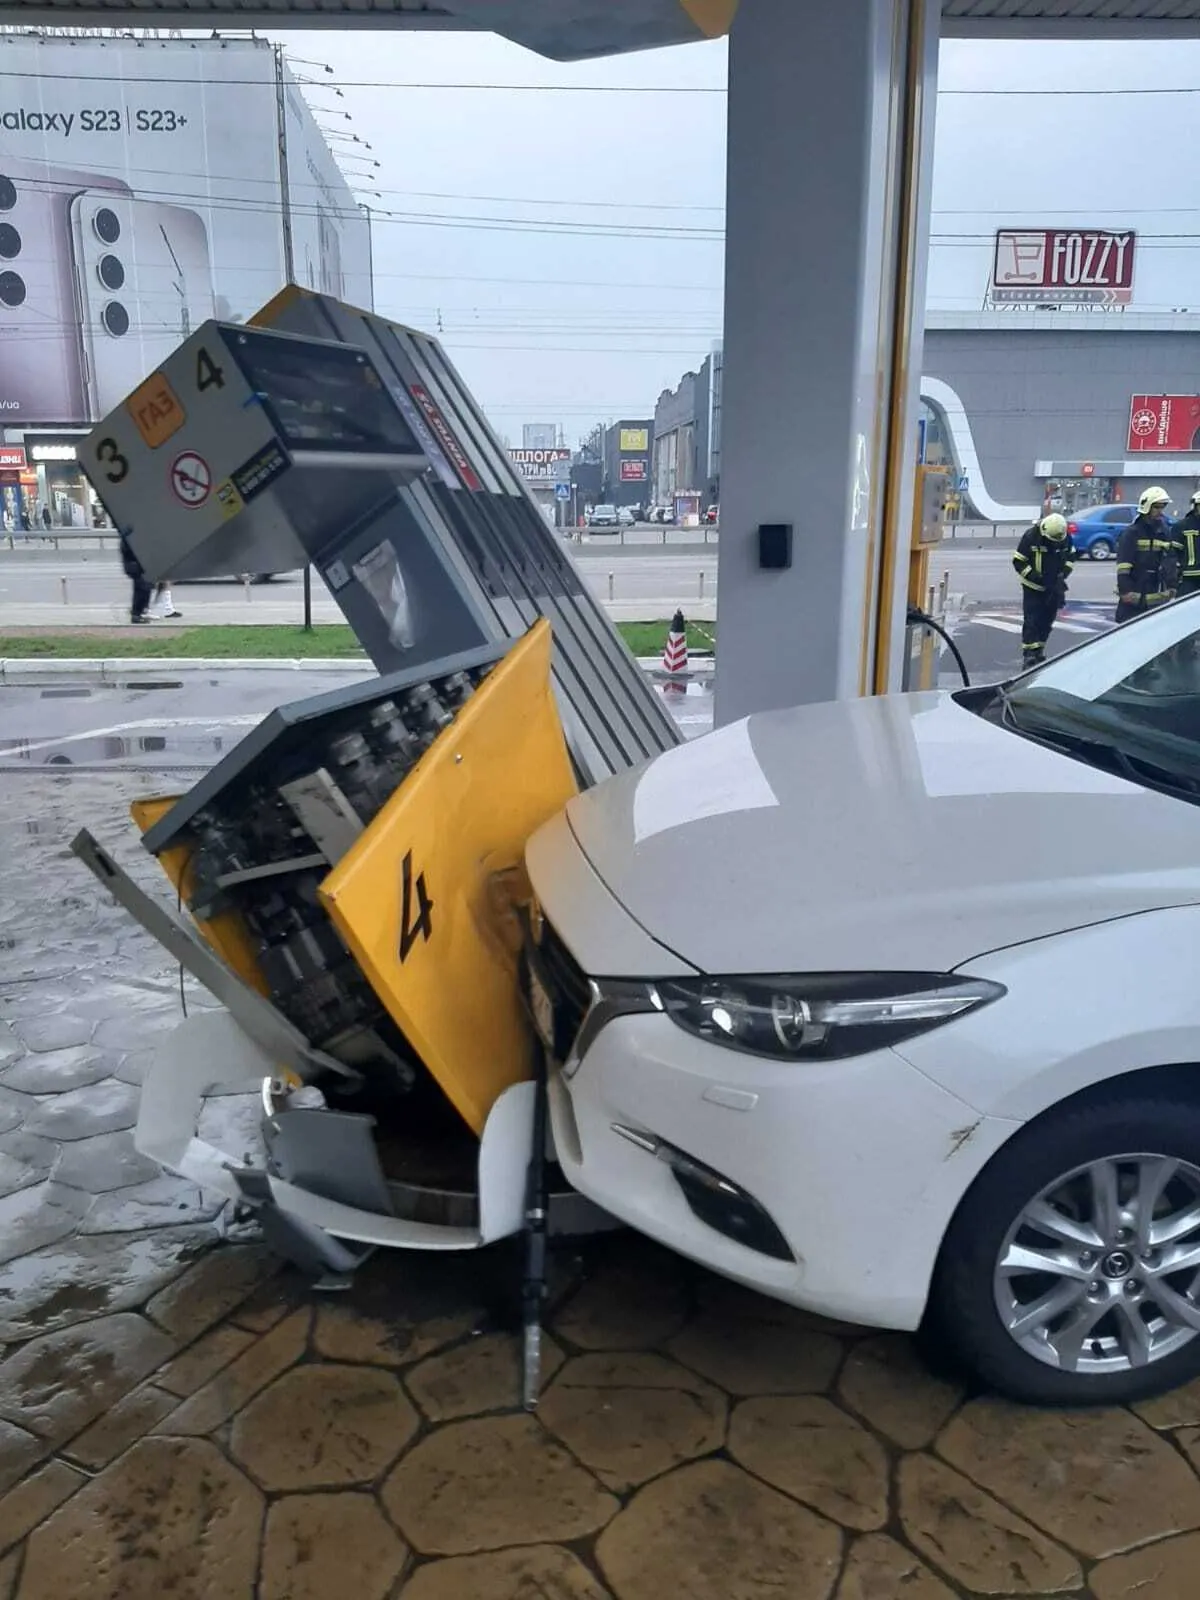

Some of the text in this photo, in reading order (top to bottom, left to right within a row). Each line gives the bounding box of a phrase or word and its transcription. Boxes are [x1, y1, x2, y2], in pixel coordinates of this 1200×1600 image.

[0, 108, 188, 137] alaxy S23 S23+
[1051, 233, 1131, 285] FOZZY
[195, 346, 226, 394] 4
[137, 389, 176, 432] ГАЗ
[96, 436, 129, 484] 3
[400, 848, 433, 965] 4
